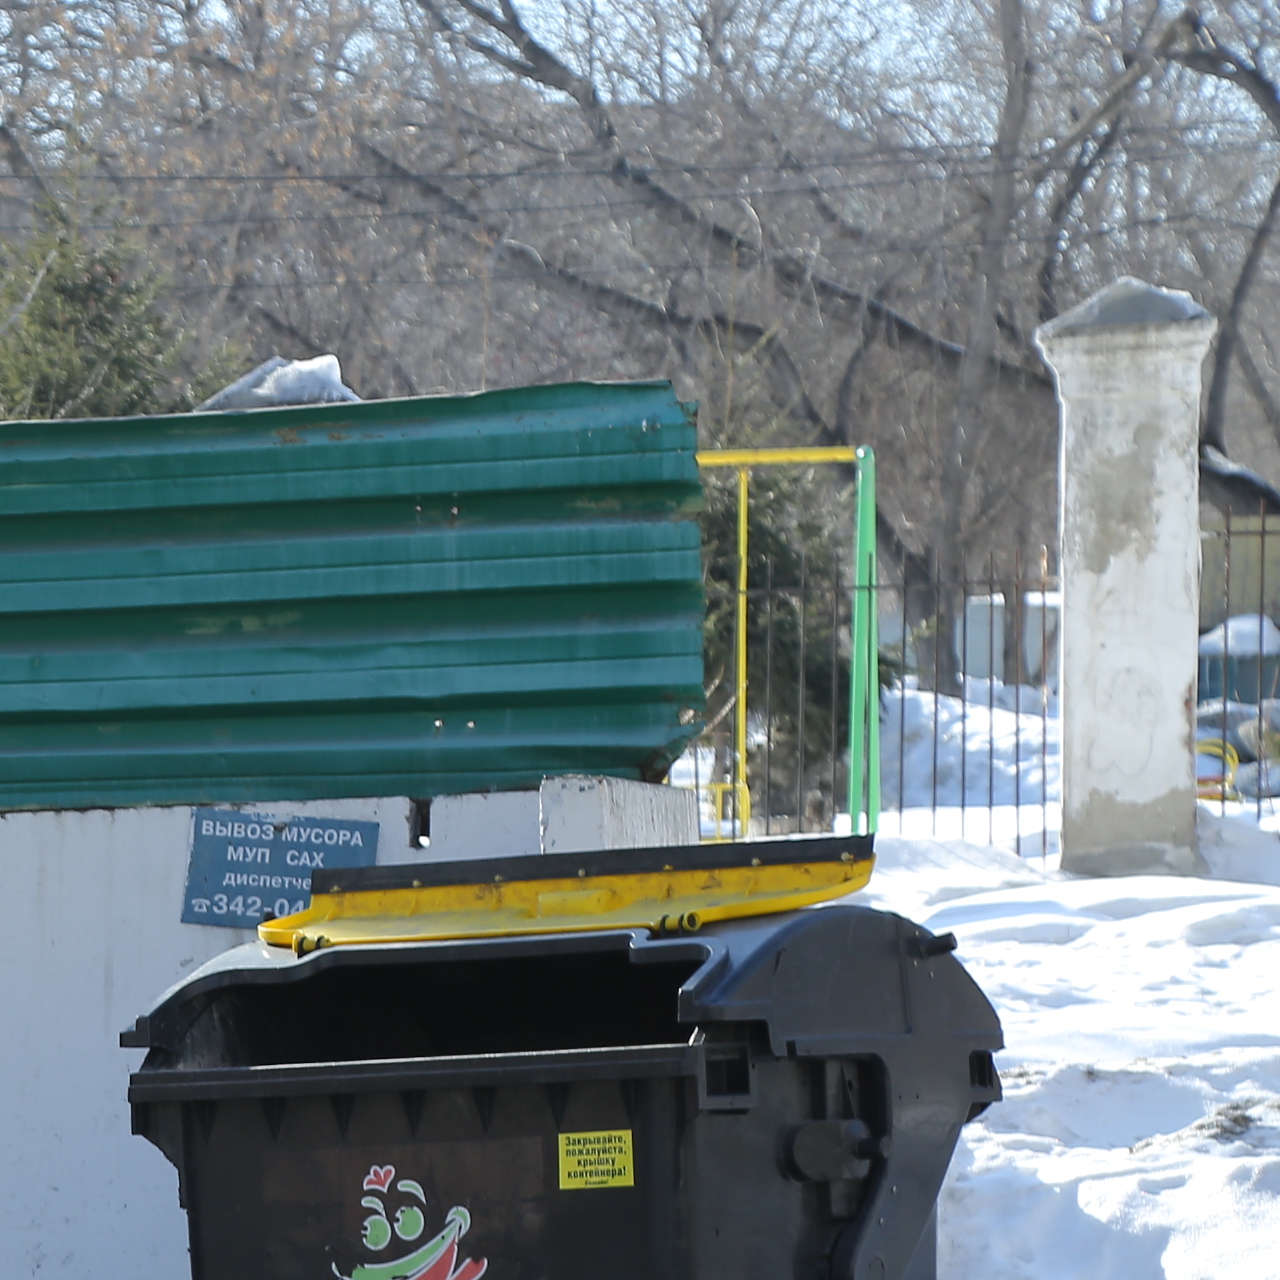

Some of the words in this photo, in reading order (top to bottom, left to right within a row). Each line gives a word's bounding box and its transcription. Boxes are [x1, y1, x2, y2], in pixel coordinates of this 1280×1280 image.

[202, 819, 275, 841] ВЫВОЗ
[282, 826, 363, 847] МУСОРА
[227, 846, 271, 864] МУП
[286, 850, 325, 867] САХ
[565, 1134, 627, 1147] Закрывайте,
[566, 1146, 627, 1157] пожалуйста,
[577, 1157, 616, 1168] крышку
[567, 1165, 627, 1179] контейнера!
